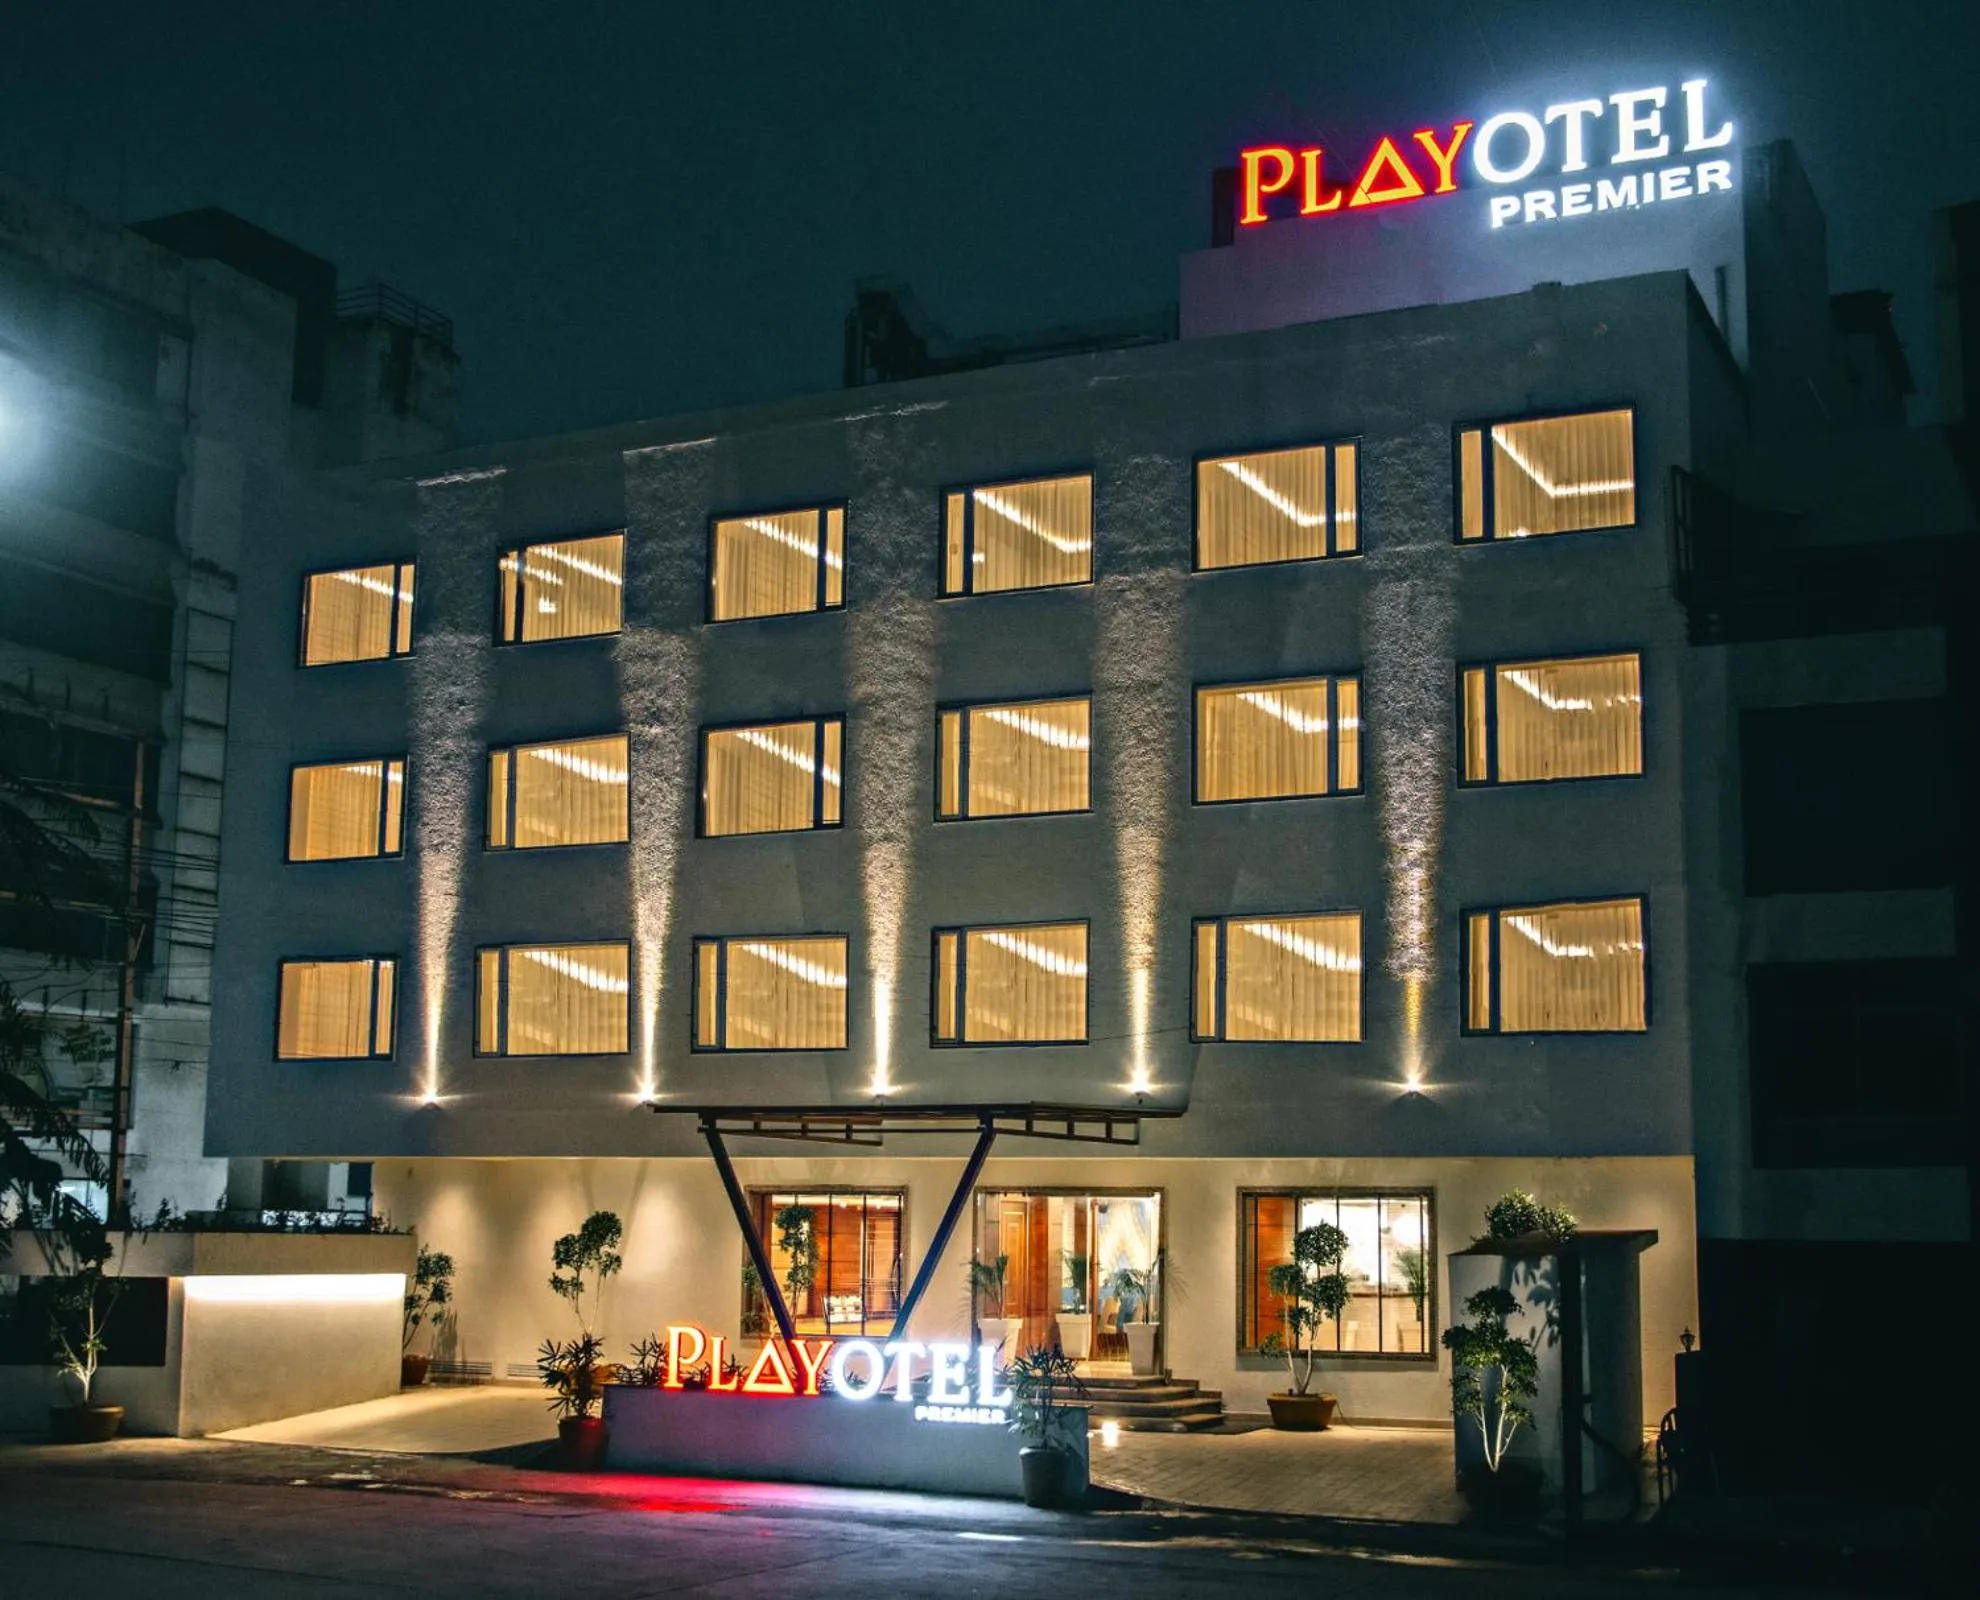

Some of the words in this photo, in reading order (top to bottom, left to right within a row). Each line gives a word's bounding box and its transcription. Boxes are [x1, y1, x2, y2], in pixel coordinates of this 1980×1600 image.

[1240, 79, 1733, 225] PLAYOTEL
[1490, 160, 1733, 228] PREMIER
[664, 1326, 1012, 1406] PLAYOTEL
